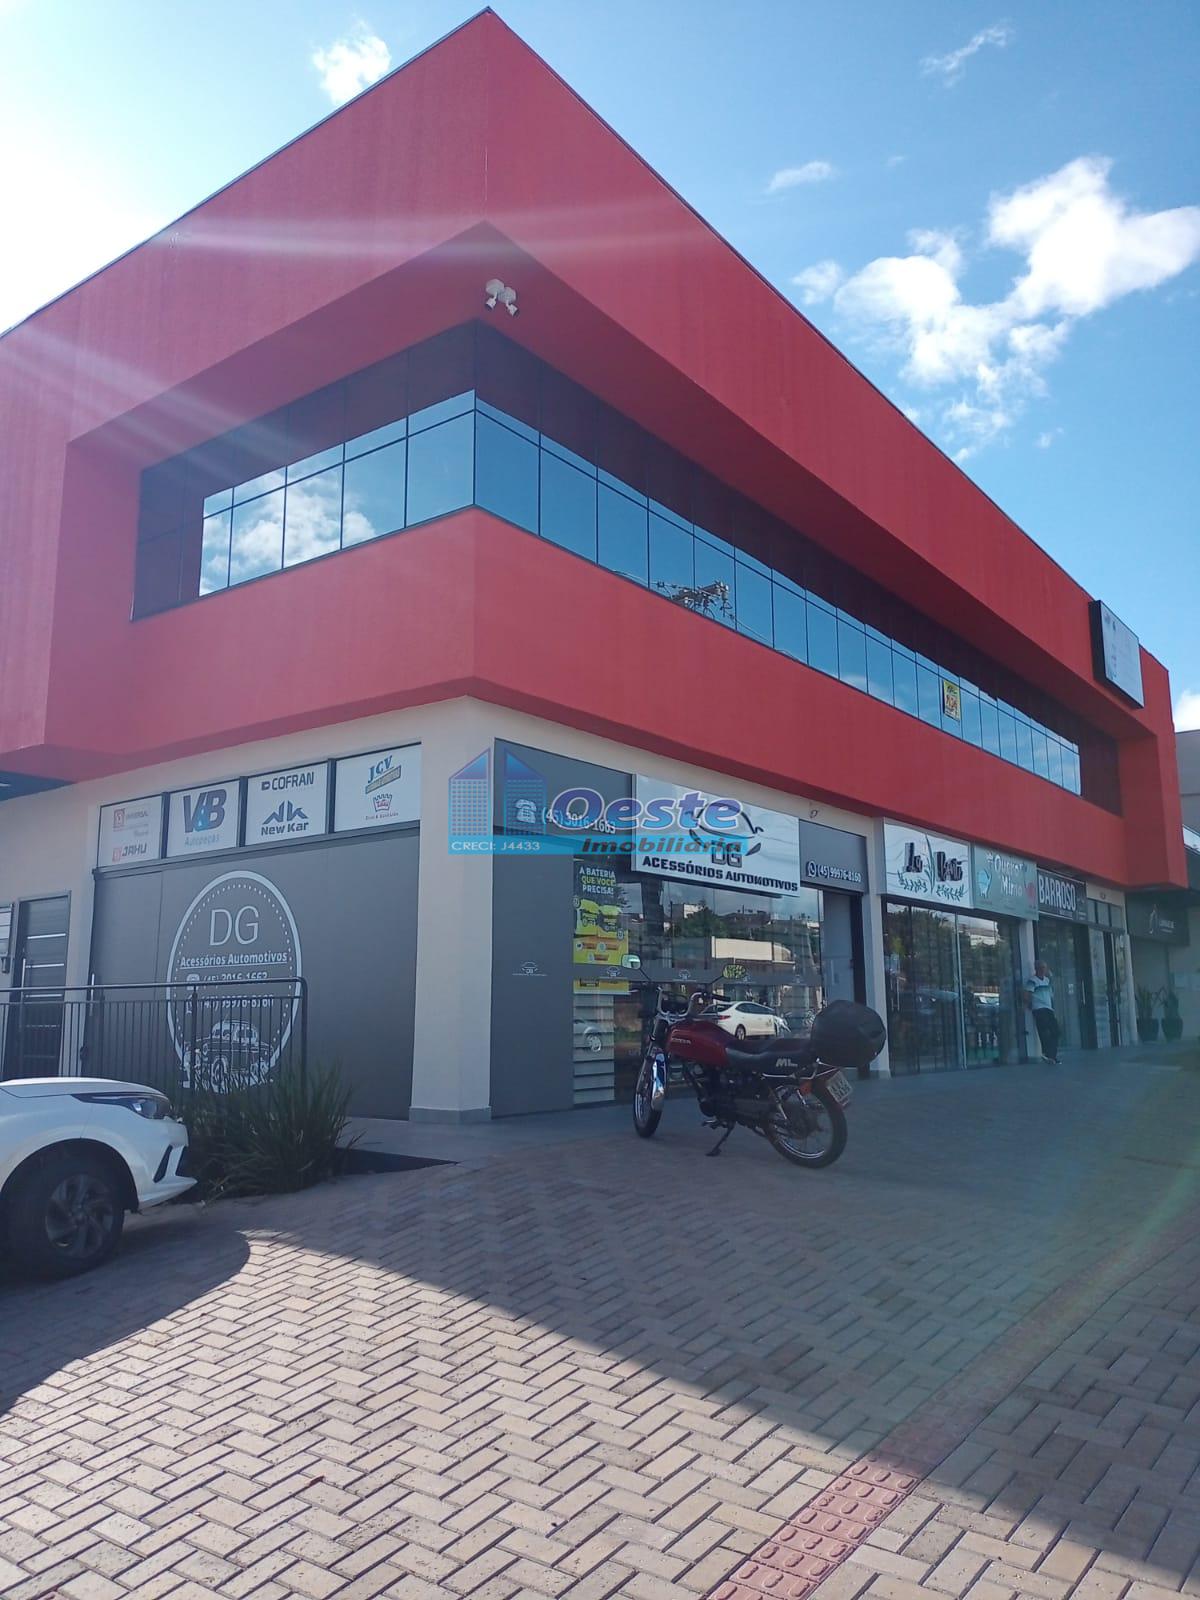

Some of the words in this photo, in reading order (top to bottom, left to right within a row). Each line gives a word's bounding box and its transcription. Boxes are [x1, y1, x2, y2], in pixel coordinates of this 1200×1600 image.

[271, 771, 315, 791] COFRAN
[261, 825, 285, 836] New
[287, 822, 309, 833] Kar
[711, 840, 743, 868] DG
[579, 866, 585, 875] A
[586, 867, 616, 878] BATERIA
[642, 856, 724, 880] ACESSÓRIOS
[725, 871, 799, 892] AUTOMOTIVOS
[1038, 874, 1077, 911] BARROSO
[209, 906, 259, 946] DG
[180, 955, 226, 967] Acessórios
[227, 951, 287, 965] Automotivos
